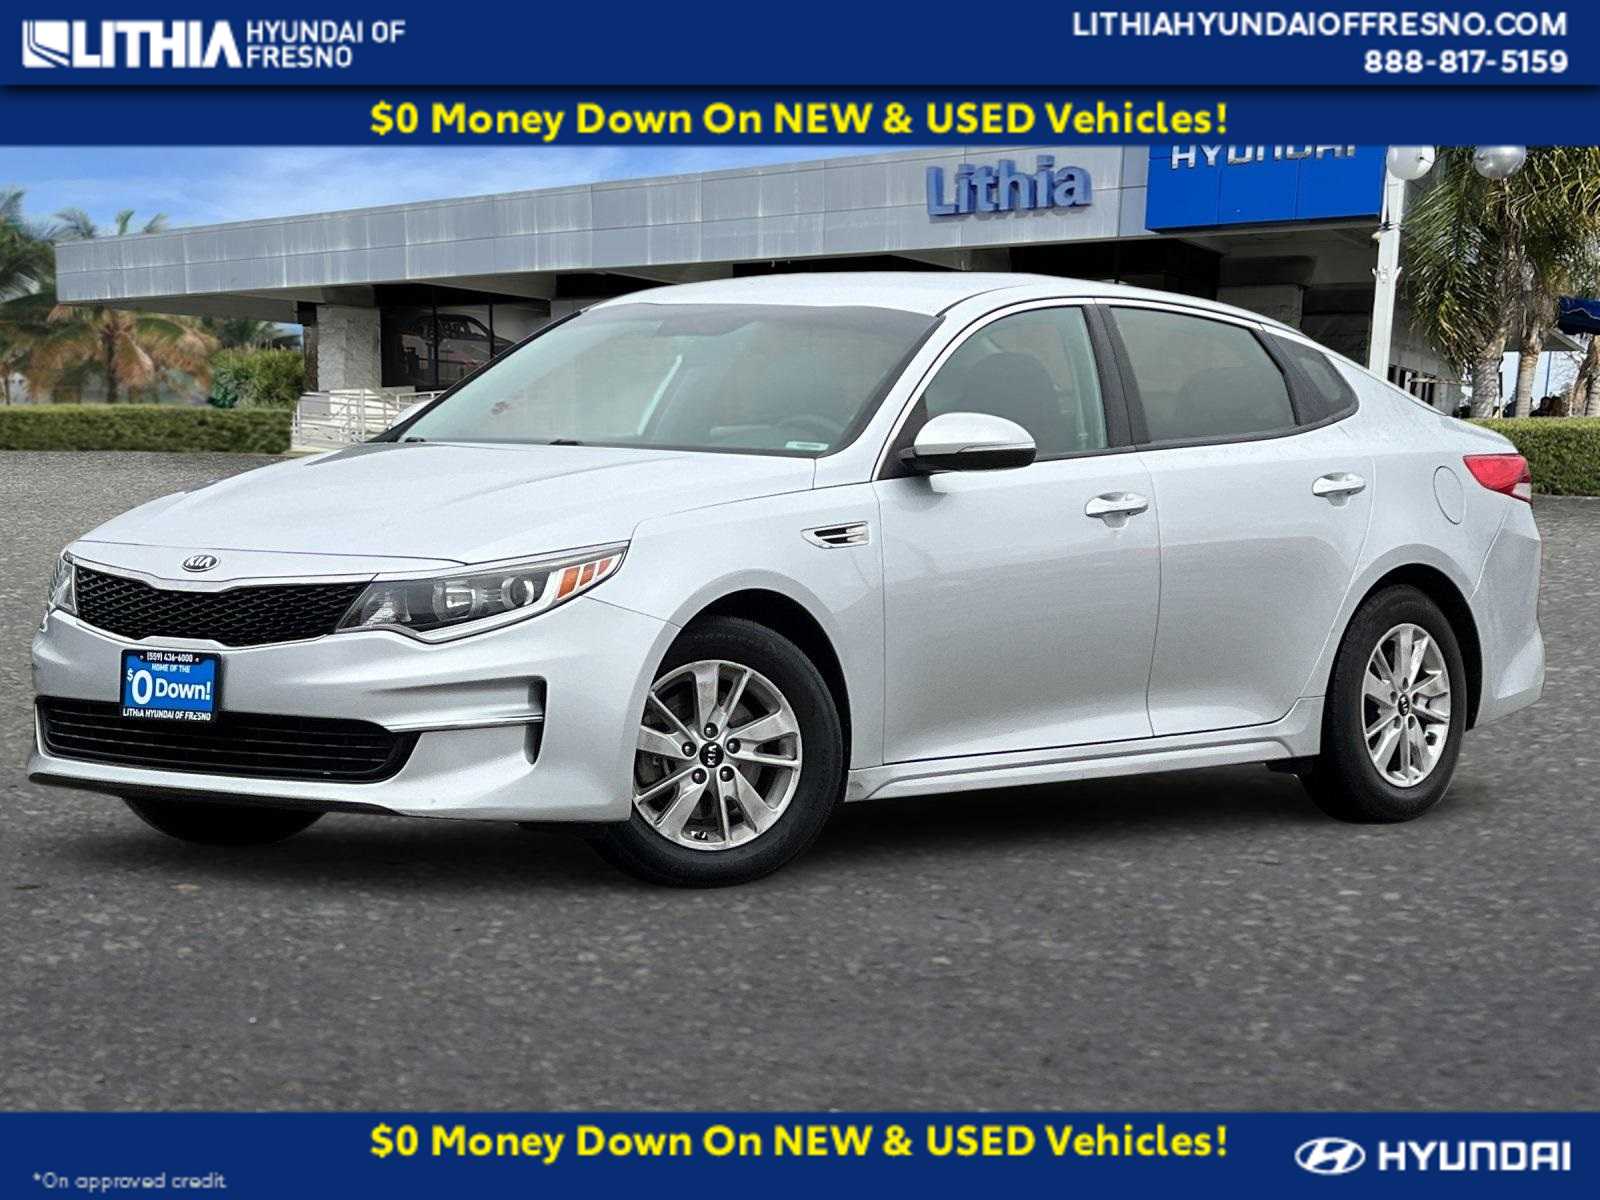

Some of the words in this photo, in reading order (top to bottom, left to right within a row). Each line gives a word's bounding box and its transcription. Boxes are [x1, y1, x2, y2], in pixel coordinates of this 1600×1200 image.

[926, 155, 1092, 216] Lithia
[169, 664, 178, 673] OF
[155, 677, 211, 701] Down!
[145, 709, 175, 719] HYUNDAI
[175, 710, 184, 719] OF
